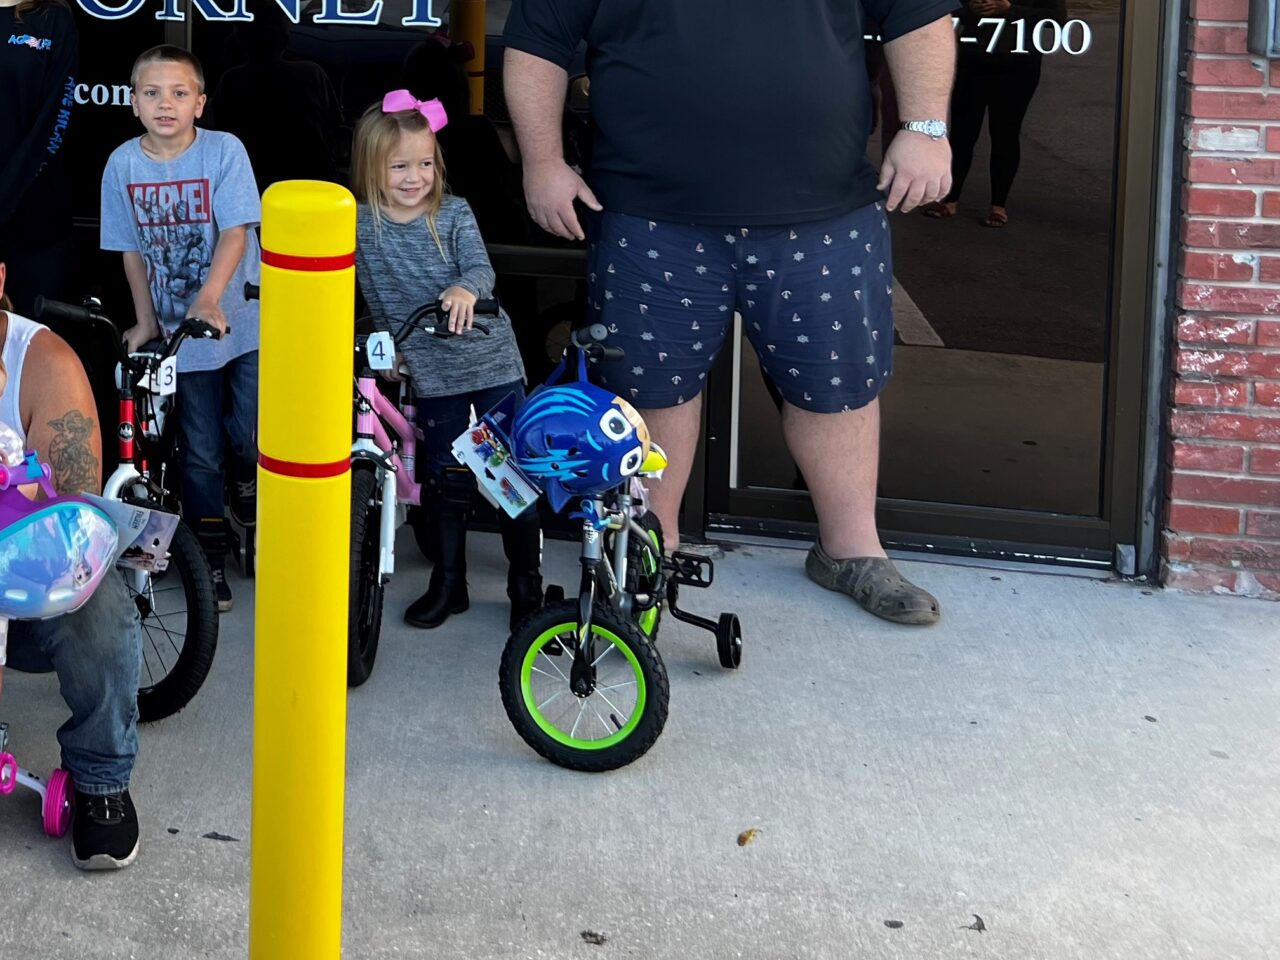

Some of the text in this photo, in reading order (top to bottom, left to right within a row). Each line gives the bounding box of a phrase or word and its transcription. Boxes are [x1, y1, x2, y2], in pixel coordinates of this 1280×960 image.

[133, 182, 208, 224] MARVEL
[371, 340, 387, 361] 4
[163, 365, 174, 387] 3
